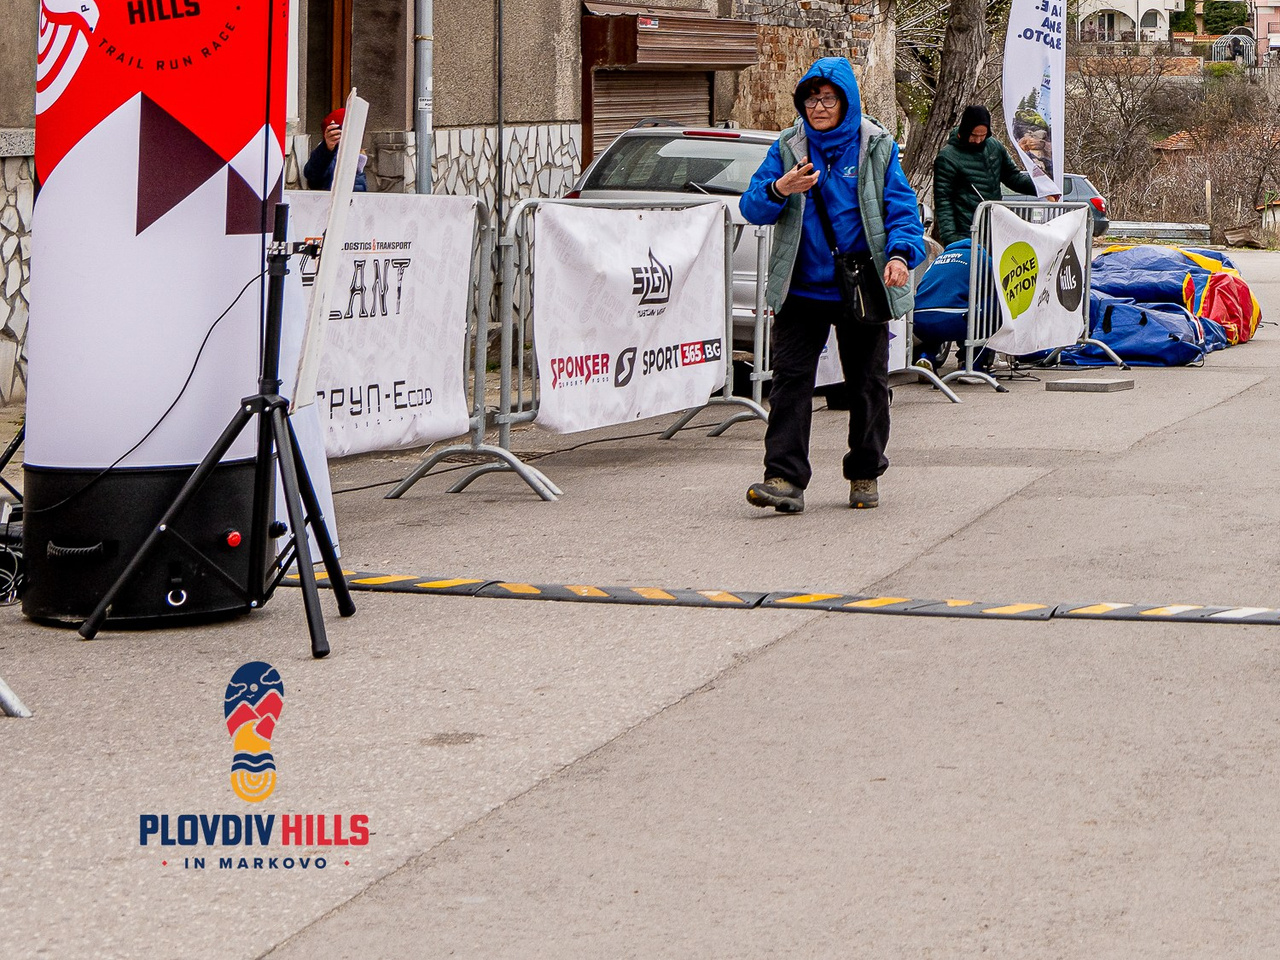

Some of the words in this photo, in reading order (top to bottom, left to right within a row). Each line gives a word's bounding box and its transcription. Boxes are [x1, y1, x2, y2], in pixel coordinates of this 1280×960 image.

[99, 38, 144, 69] TRAIL
[156, 56, 193, 70] RUN
[201, 22, 236, 58] RACE
[376, 241, 412, 249] TRANSPORT
[550, 353, 610, 390] SPONSER
